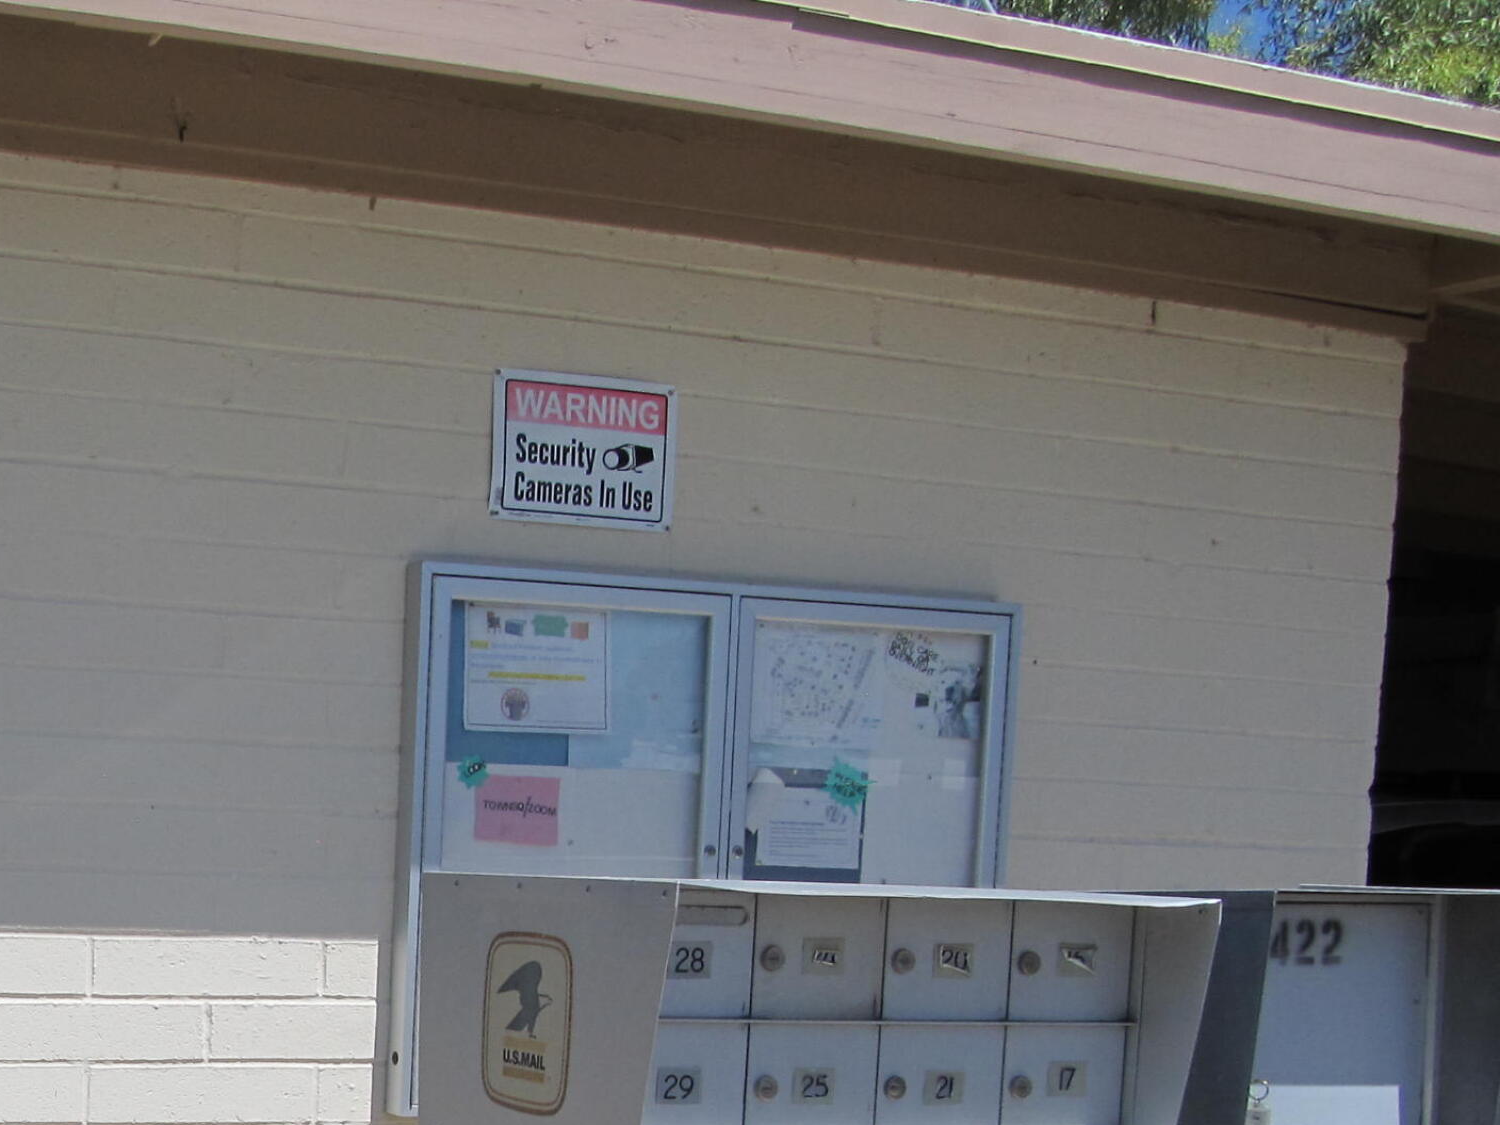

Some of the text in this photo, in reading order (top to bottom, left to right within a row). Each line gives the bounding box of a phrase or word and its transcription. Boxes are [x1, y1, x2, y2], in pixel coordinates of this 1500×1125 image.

[514, 387, 660, 430] WARNING
[515, 432, 596, 476] Security
[513, 471, 653, 513] Cameras In Use
[674, 946, 705, 974] 28
[663, 1073, 695, 1100] 29
[801, 1074, 829, 1098] 25
[935, 1075, 954, 1100] 21
[1058, 1066, 1076, 1091] 17
